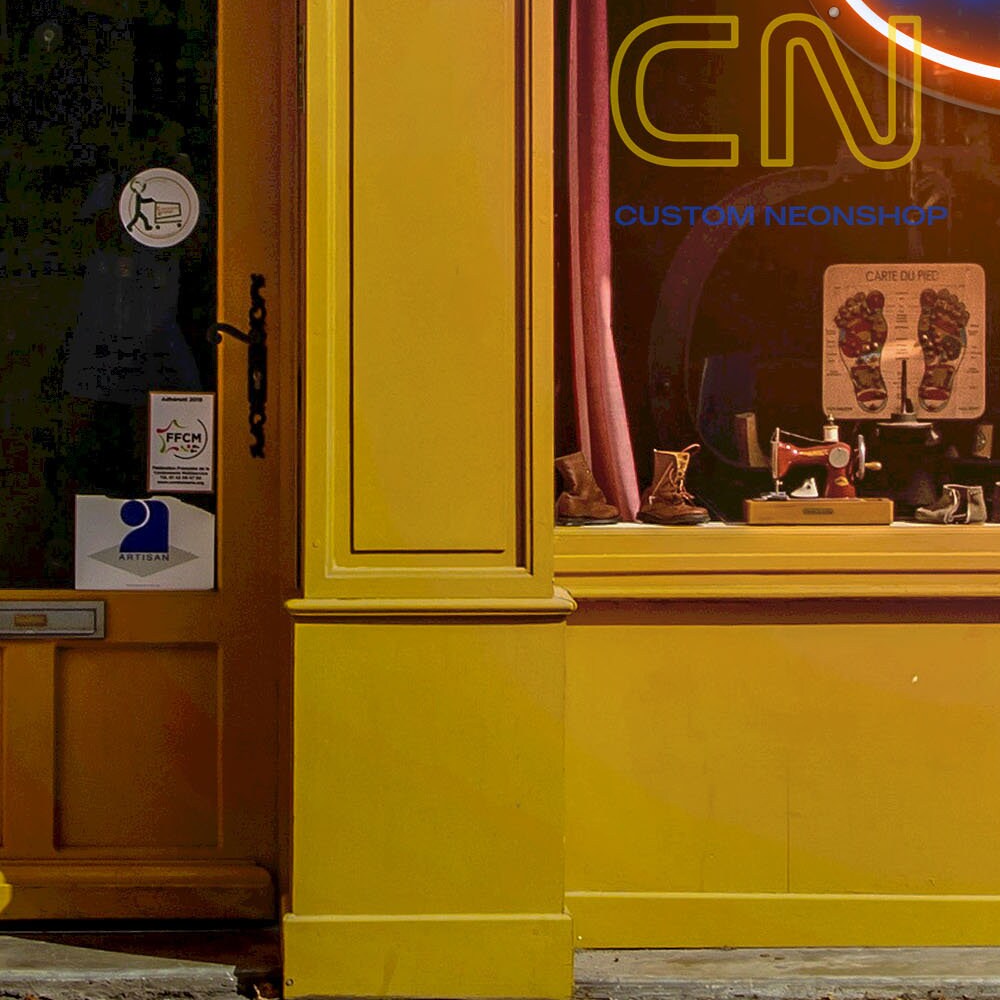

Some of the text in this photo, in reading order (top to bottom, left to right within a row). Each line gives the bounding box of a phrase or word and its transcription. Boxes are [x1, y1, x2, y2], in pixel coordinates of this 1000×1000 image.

[865, 270, 897, 281] CARTE
[900, 270, 915, 281] DU
[166, 432, 201, 443] FFCM
[119, 553, 169, 561] ARTISAN
